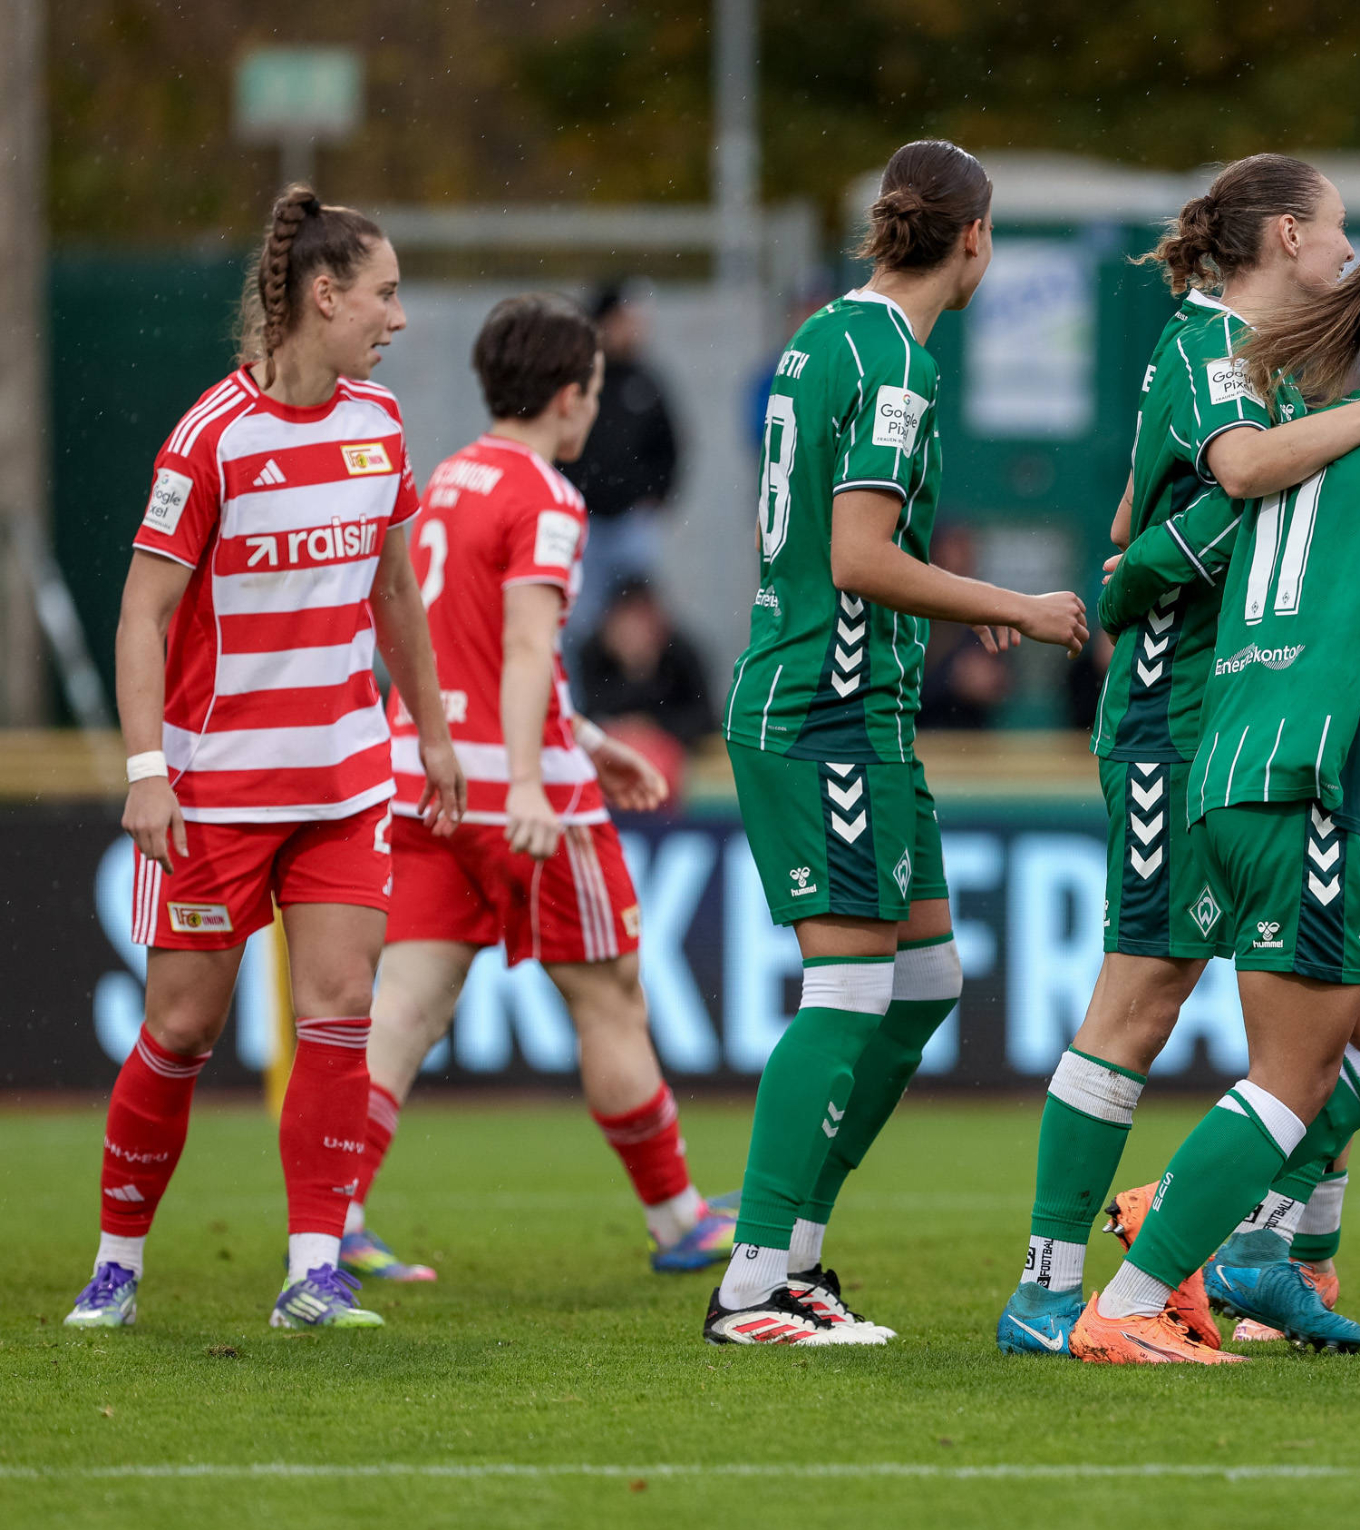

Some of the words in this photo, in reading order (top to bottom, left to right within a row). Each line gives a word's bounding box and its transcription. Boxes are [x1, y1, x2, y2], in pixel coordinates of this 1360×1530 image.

[287, 514, 378, 564] raisin
[1244, 467, 1327, 627] 11
[790, 883, 818, 897] hummel
[1252, 939, 1285, 949] hummel
